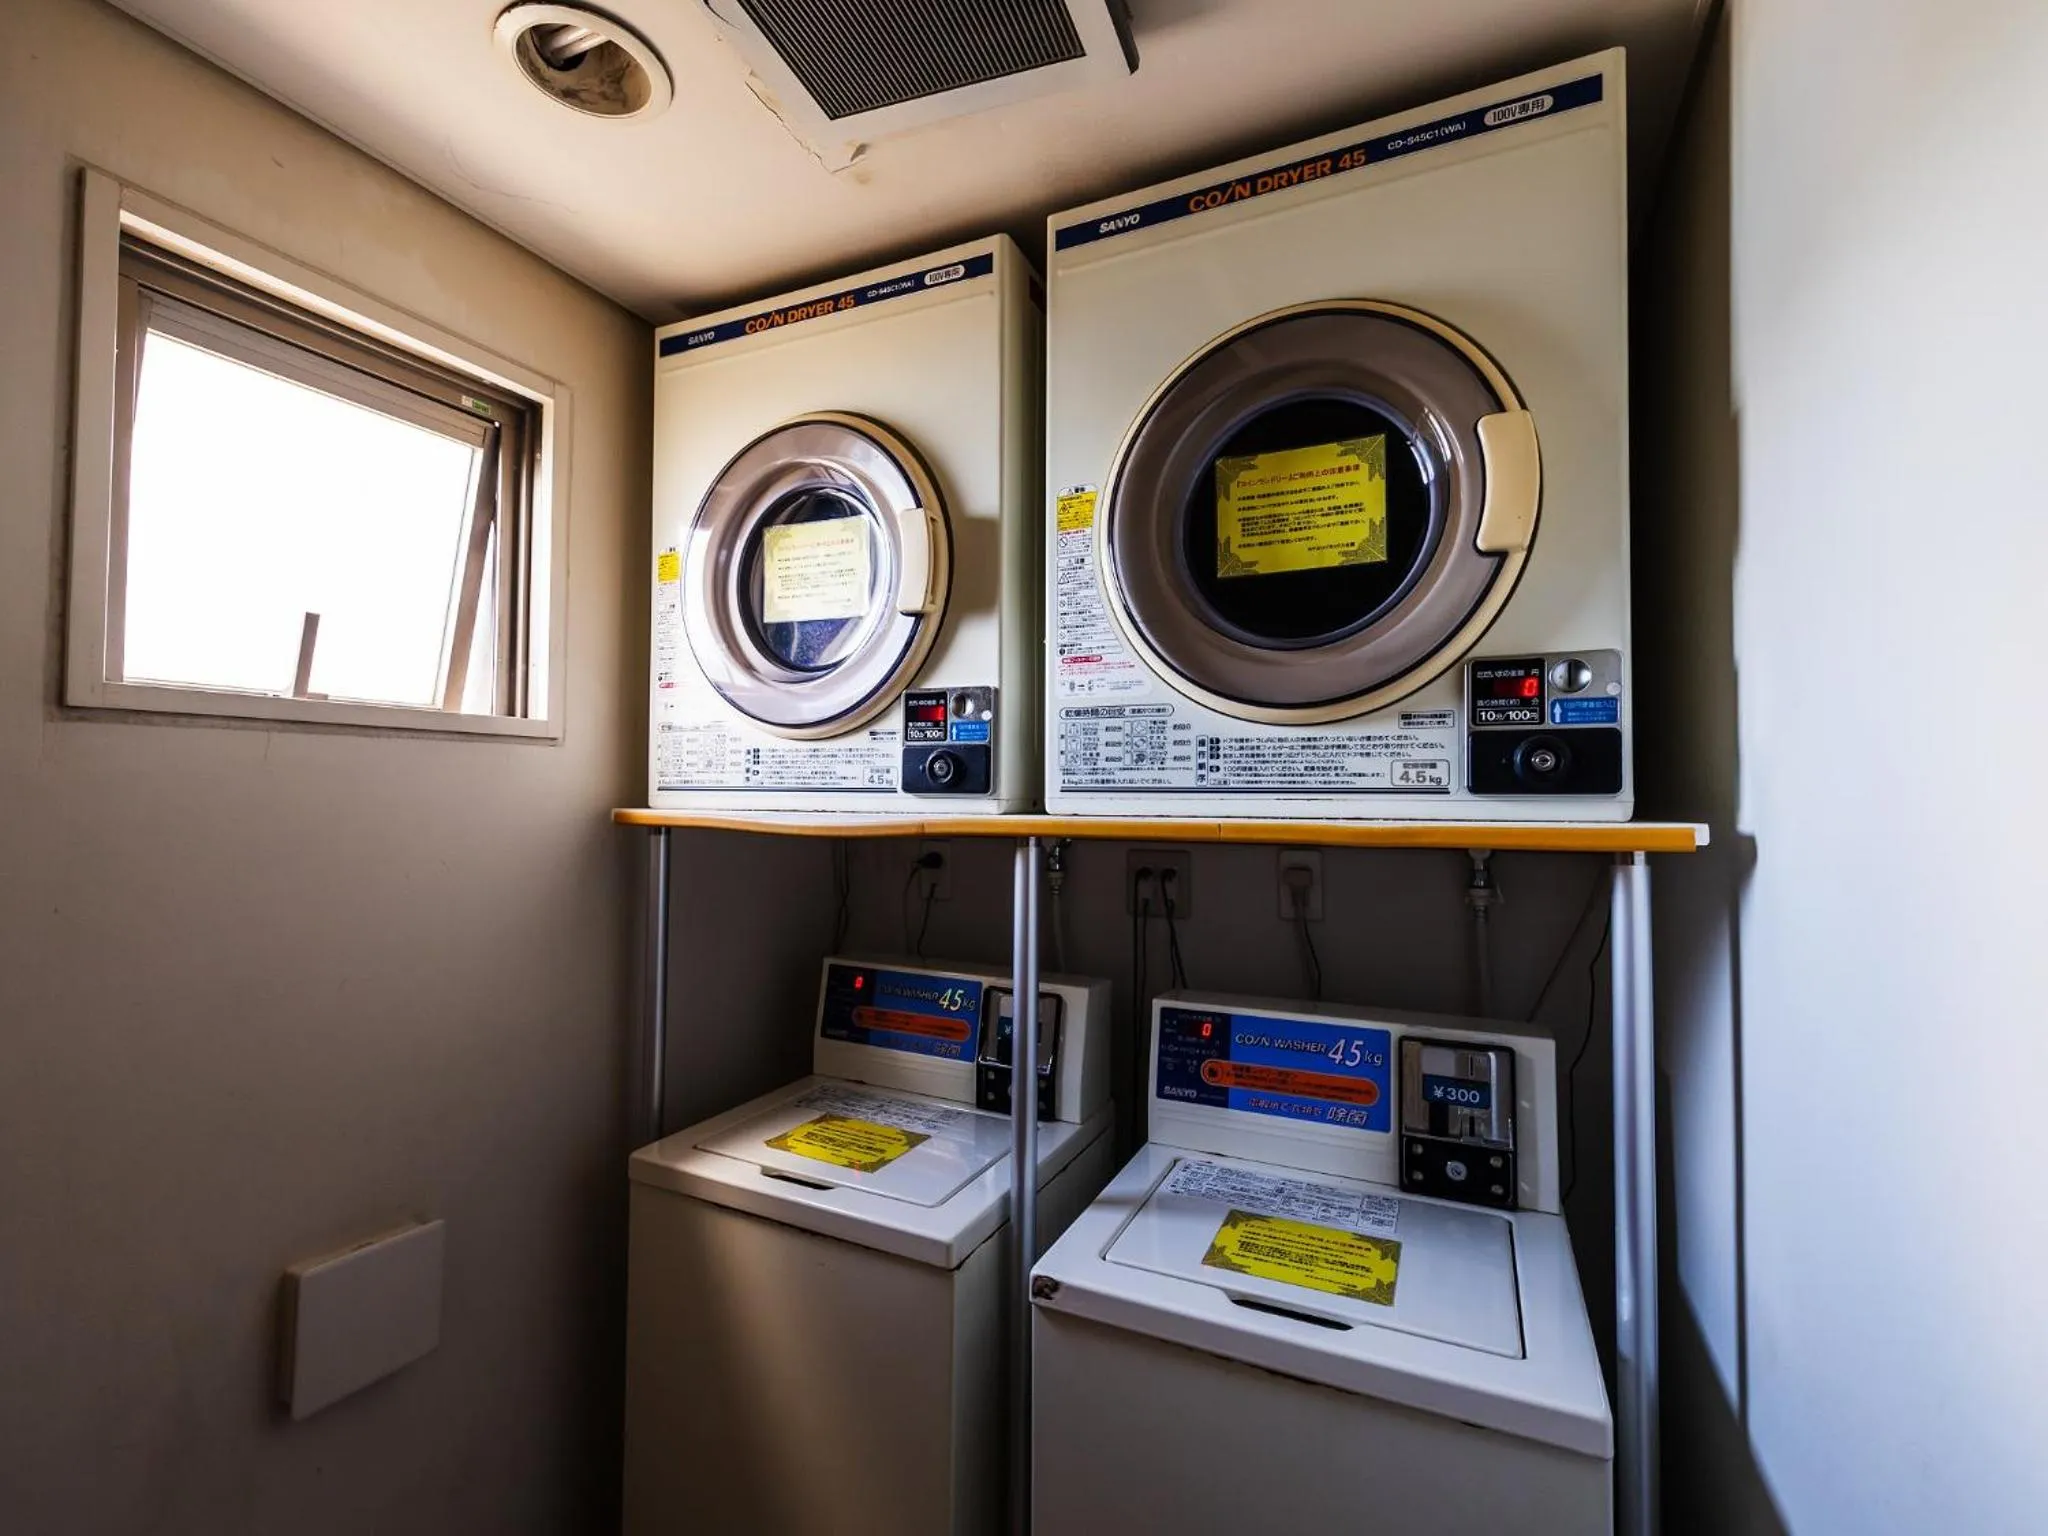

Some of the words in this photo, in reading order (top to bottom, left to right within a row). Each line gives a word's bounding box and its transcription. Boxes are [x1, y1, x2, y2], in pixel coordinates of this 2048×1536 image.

[1491, 97, 1547, 125] 100V専用
[1256, 160, 1332, 194] DRYER
[1338, 149, 1367, 171] 45
[1098, 213, 1141, 234] SANYO
[787, 301, 834, 325] DRYER
[837, 295, 855, 311] 45
[687, 331, 715, 346] SANYO
[1524, 678, 1539, 697] 0
[1202, 1023, 1212, 1037] 0
[1273, 1038, 1327, 1053] WASHER
[1163, 1086, 1197, 1098] SANYO
[1433, 1084, 1480, 1103] ¥300
